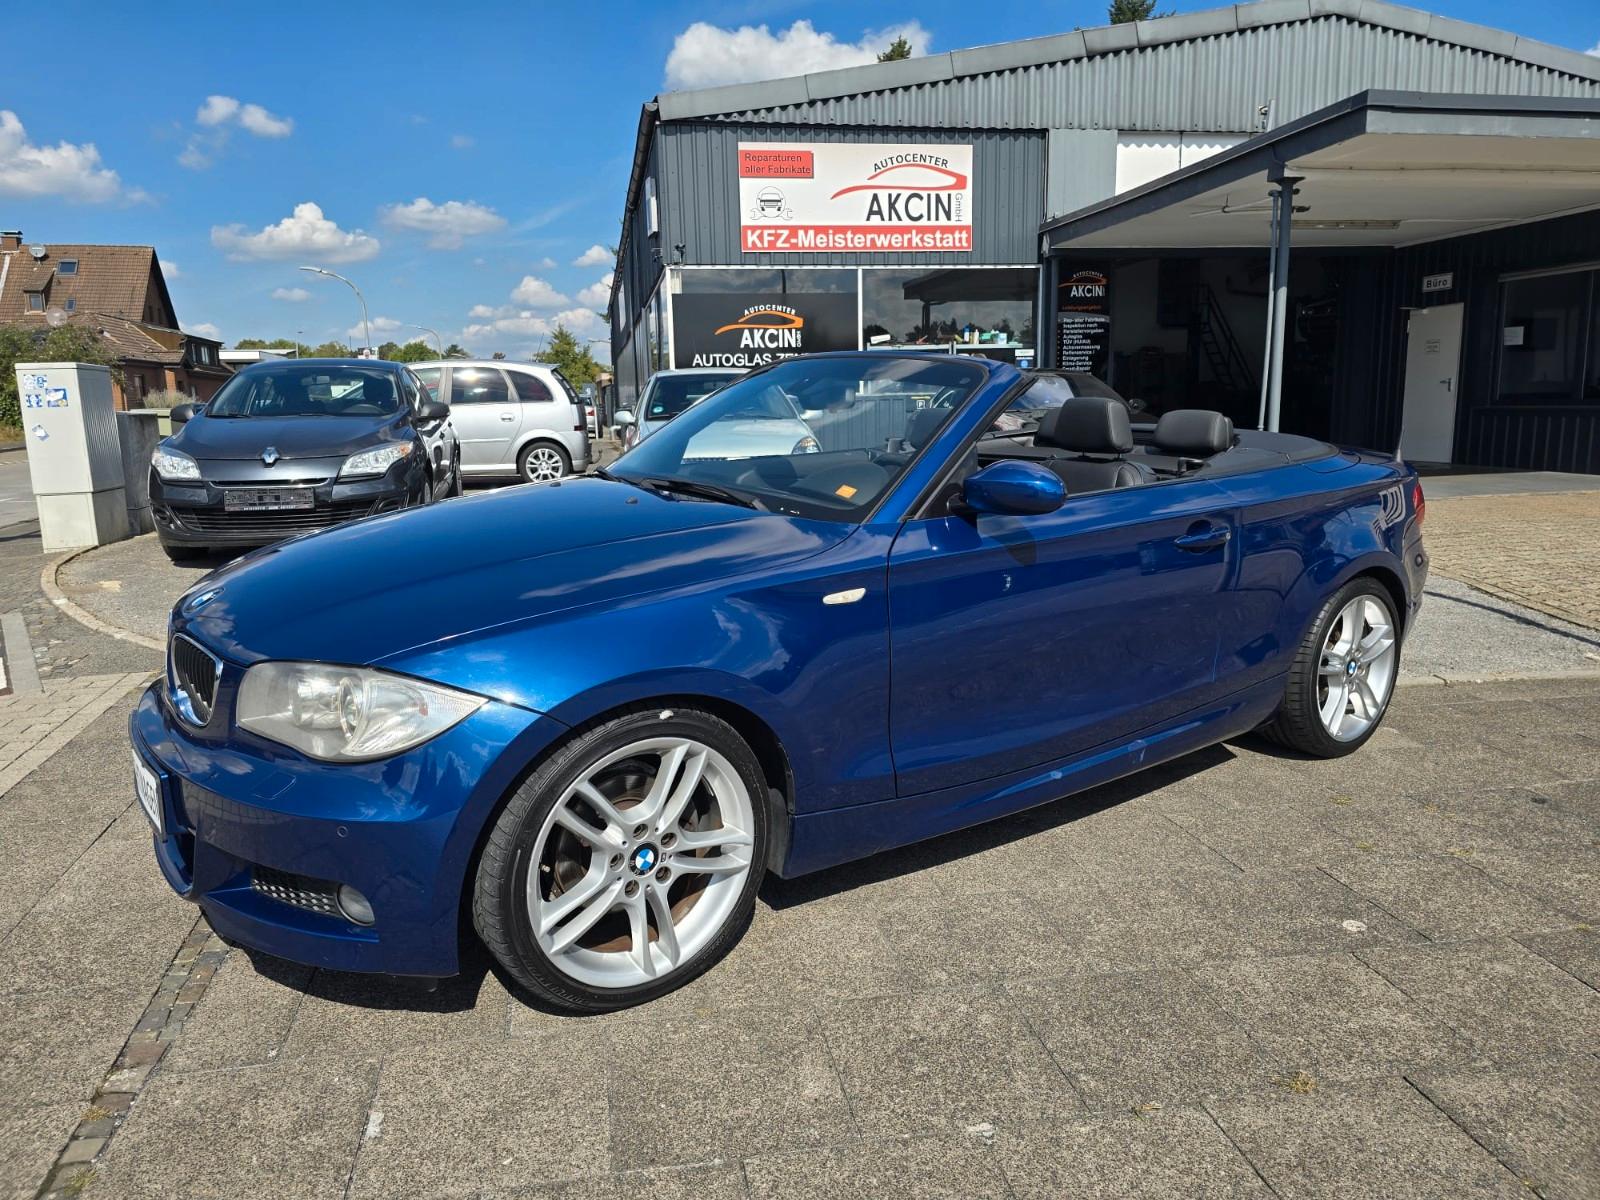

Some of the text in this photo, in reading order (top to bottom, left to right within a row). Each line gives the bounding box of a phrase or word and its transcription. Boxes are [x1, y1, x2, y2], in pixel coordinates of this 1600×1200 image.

[744, 153, 802, 163] Reparaturen
[873, 153, 949, 172] AUTOCENTER
[744, 165, 811, 174] aller Fabrikate
[865, 192, 952, 222] AKCIN
[954, 192, 963, 223] GmbH
[746, 229, 968, 248] KFZ-Meisterwerkstatt
[1070, 285, 1102, 297] AKCIN
[744, 304, 796, 316] AUTOCENTER
[740, 328, 796, 349] AKCIN
[692, 353, 772, 367] AUTOGLAS
